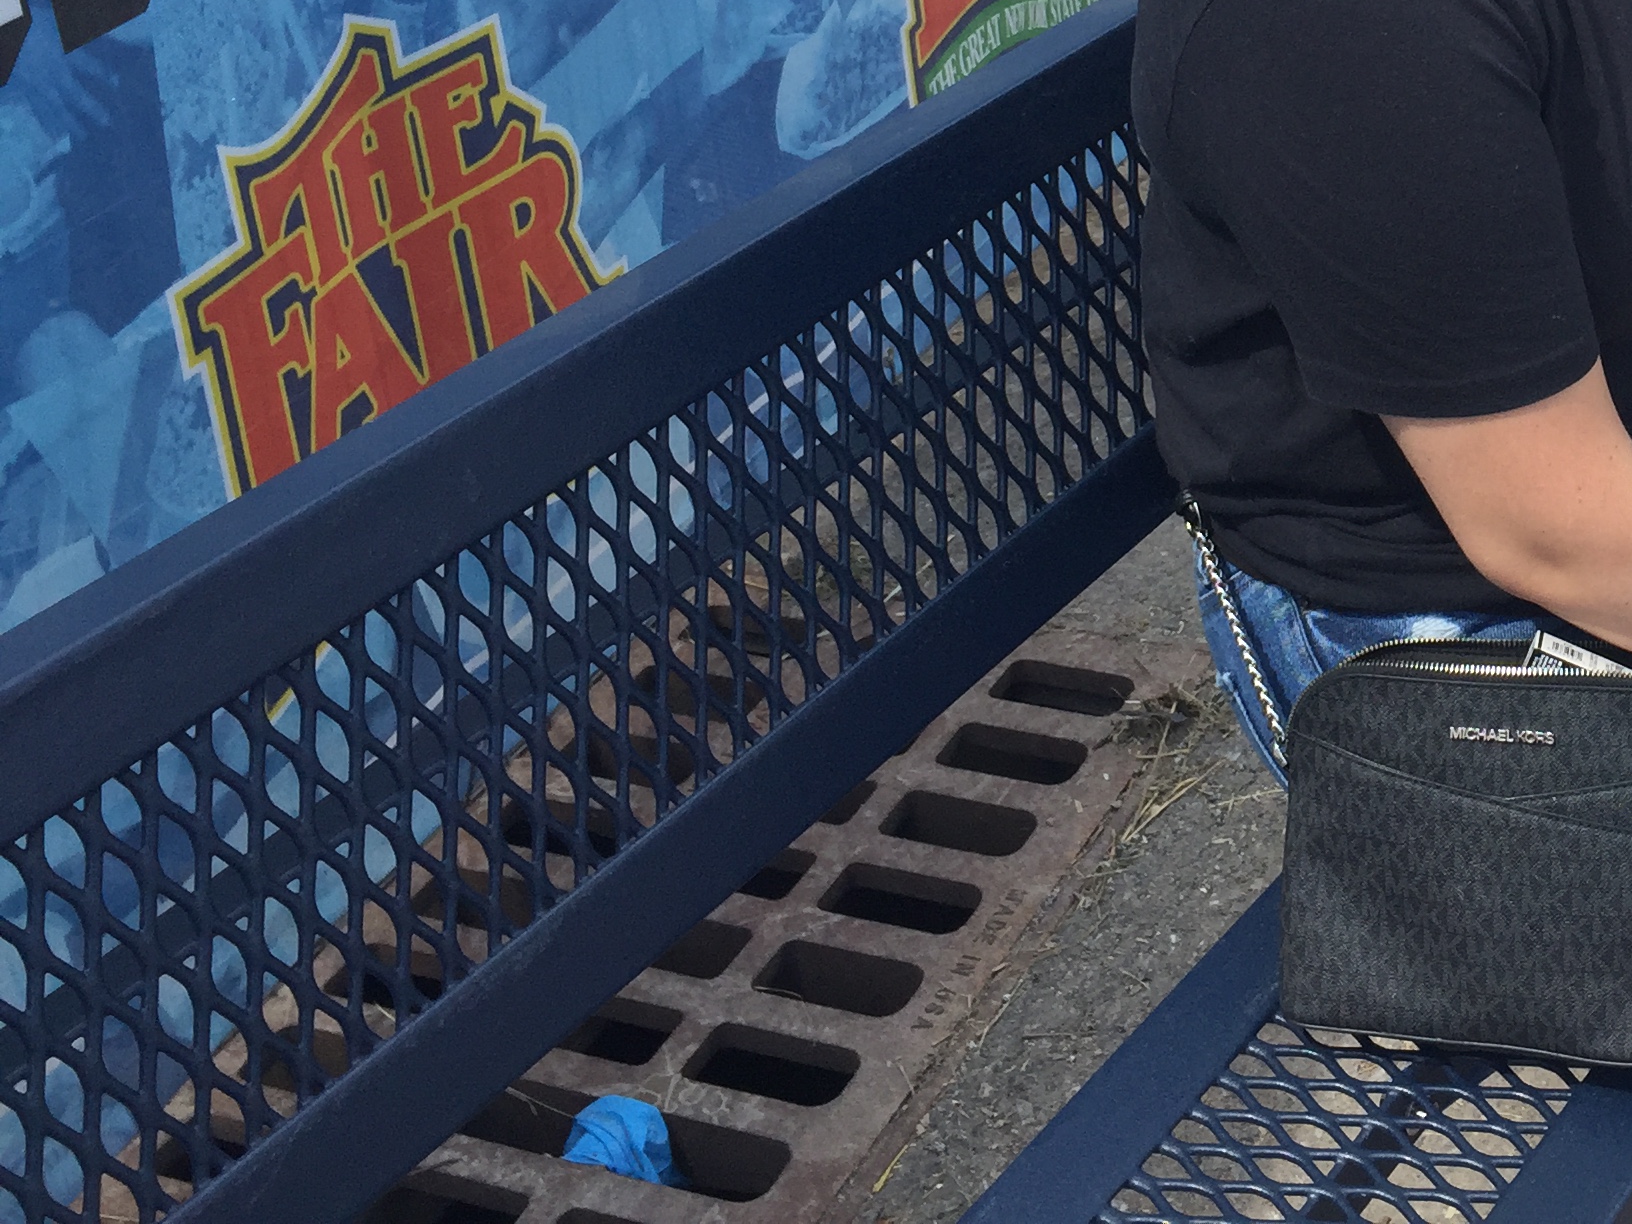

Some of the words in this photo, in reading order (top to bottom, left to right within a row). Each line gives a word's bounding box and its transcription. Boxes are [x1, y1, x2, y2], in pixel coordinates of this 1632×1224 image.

[958, 13, 1001, 77] GREAT
[250, 48, 525, 282] THE
[200, 156, 592, 489] FAIR
[1449, 726, 1514, 743] MICHAEL
[1516, 729, 1555, 745] KORS
